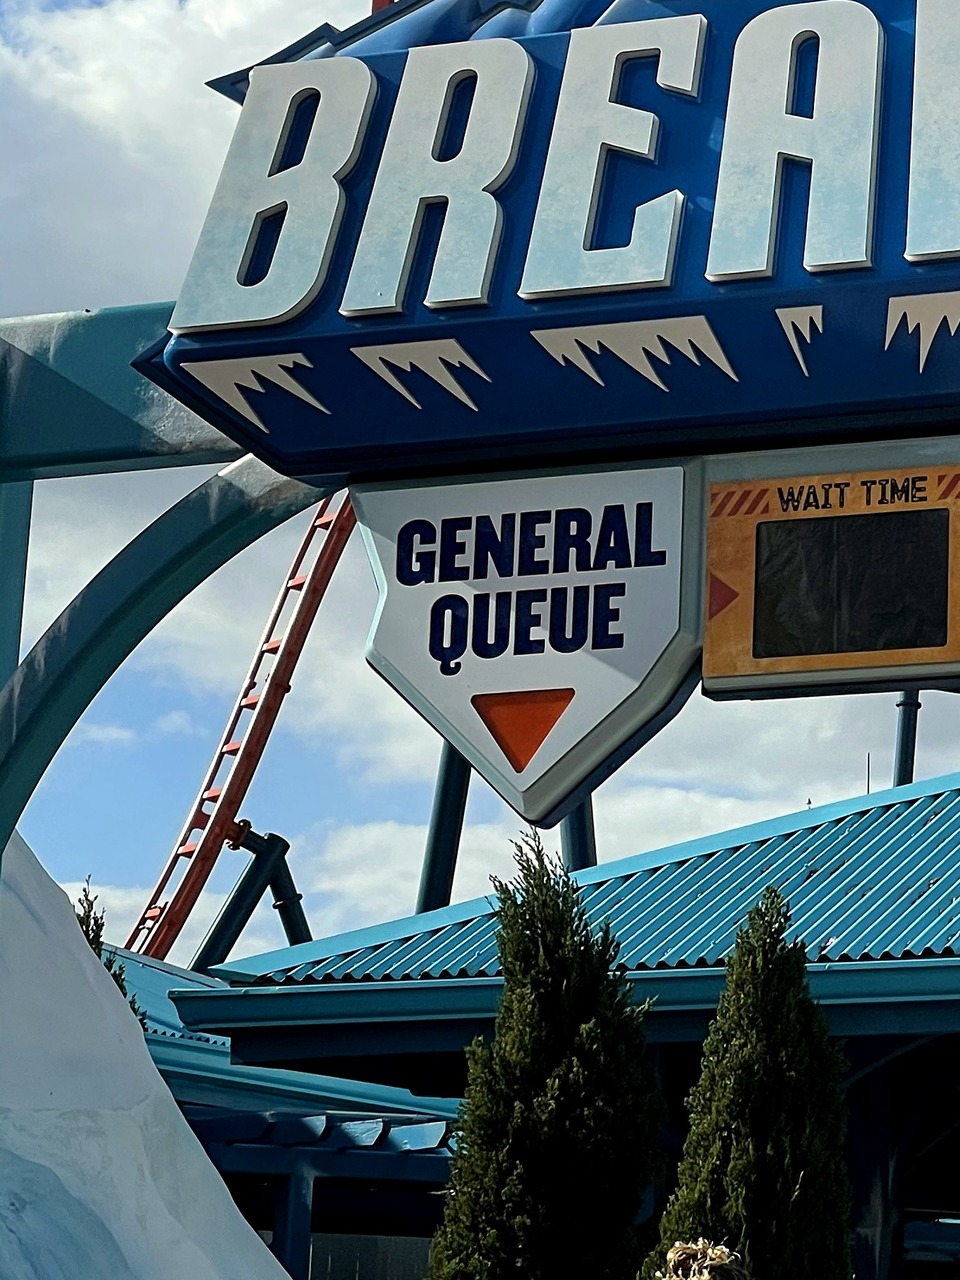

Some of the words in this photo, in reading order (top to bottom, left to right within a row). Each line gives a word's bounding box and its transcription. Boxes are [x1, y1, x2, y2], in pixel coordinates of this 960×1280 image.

[777, 482, 851, 513] WAIT
[860, 475, 928, 506] TIME
[396, 501, 667, 587] GENERAL
[428, 582, 626, 676] QUEUE
